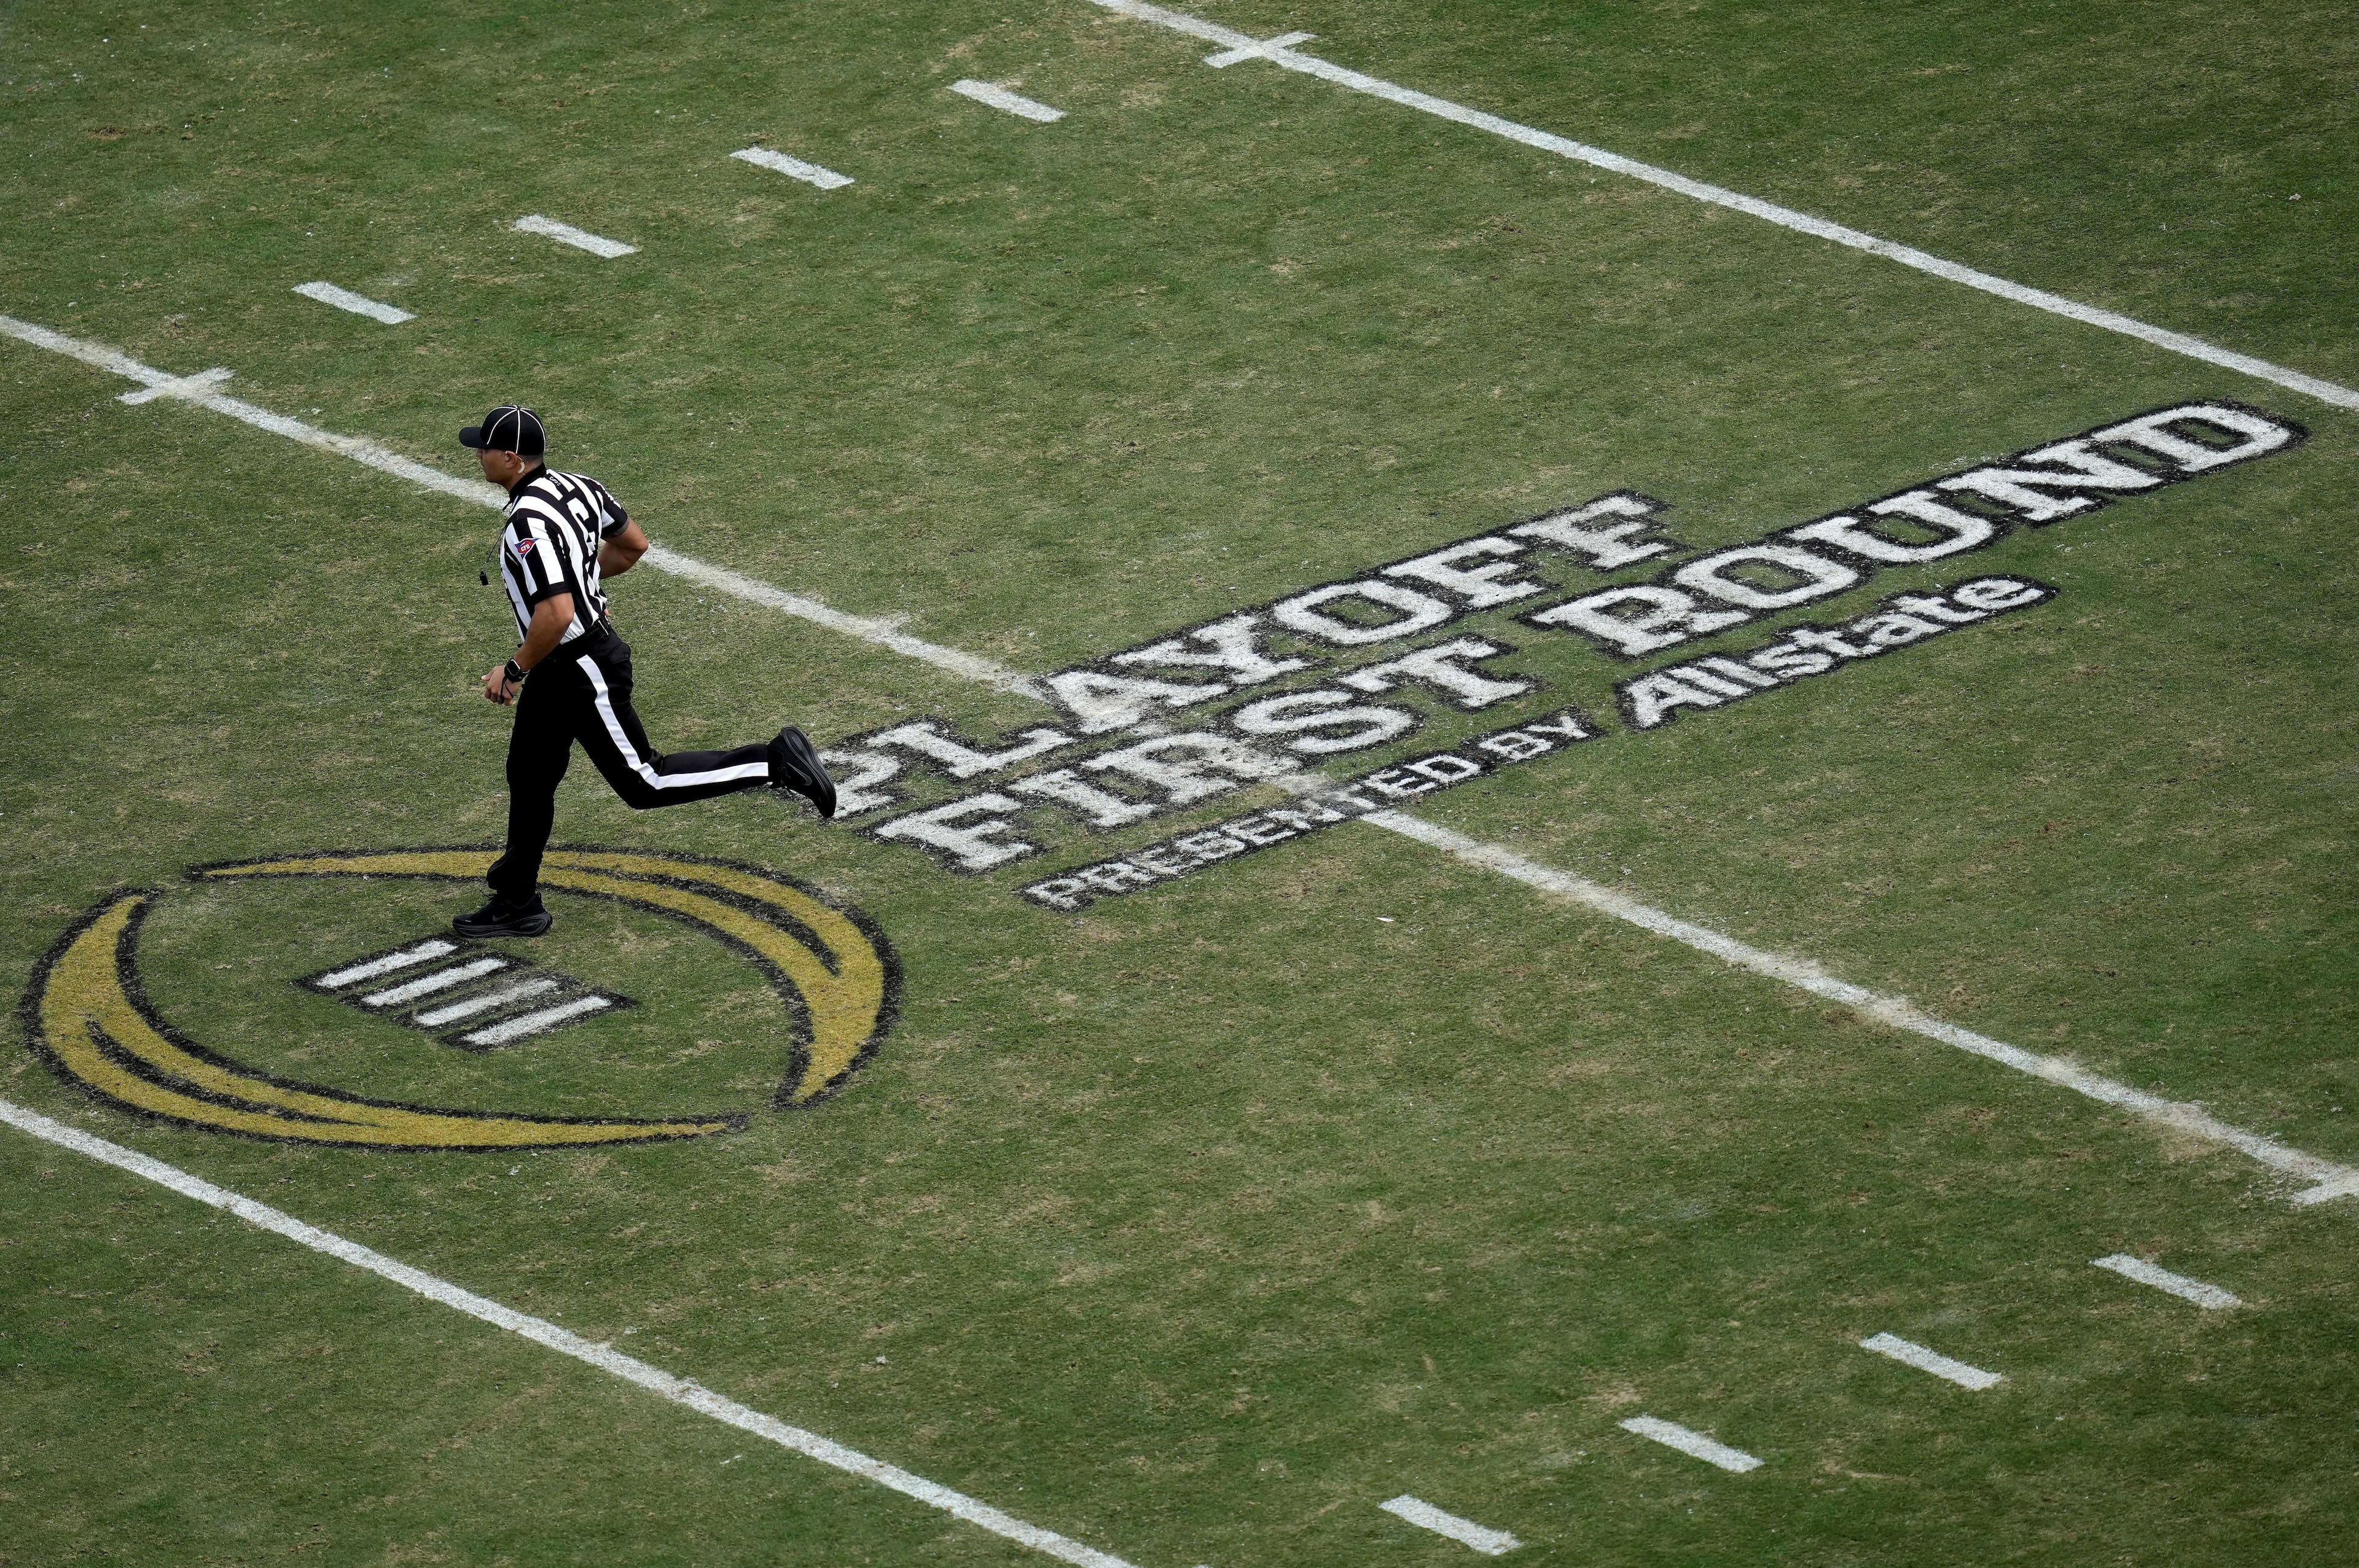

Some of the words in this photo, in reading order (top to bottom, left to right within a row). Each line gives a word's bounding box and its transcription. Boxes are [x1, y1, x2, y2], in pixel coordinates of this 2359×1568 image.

[808, 490, 1675, 821] PLAYOFF
[874, 636, 1531, 870] FIRST
[1532, 402, 2293, 655] ROUND
[1025, 754, 1482, 910] PRESENTED
[1478, 714, 1594, 763] BY
[1625, 577, 2049, 730] Allstate
